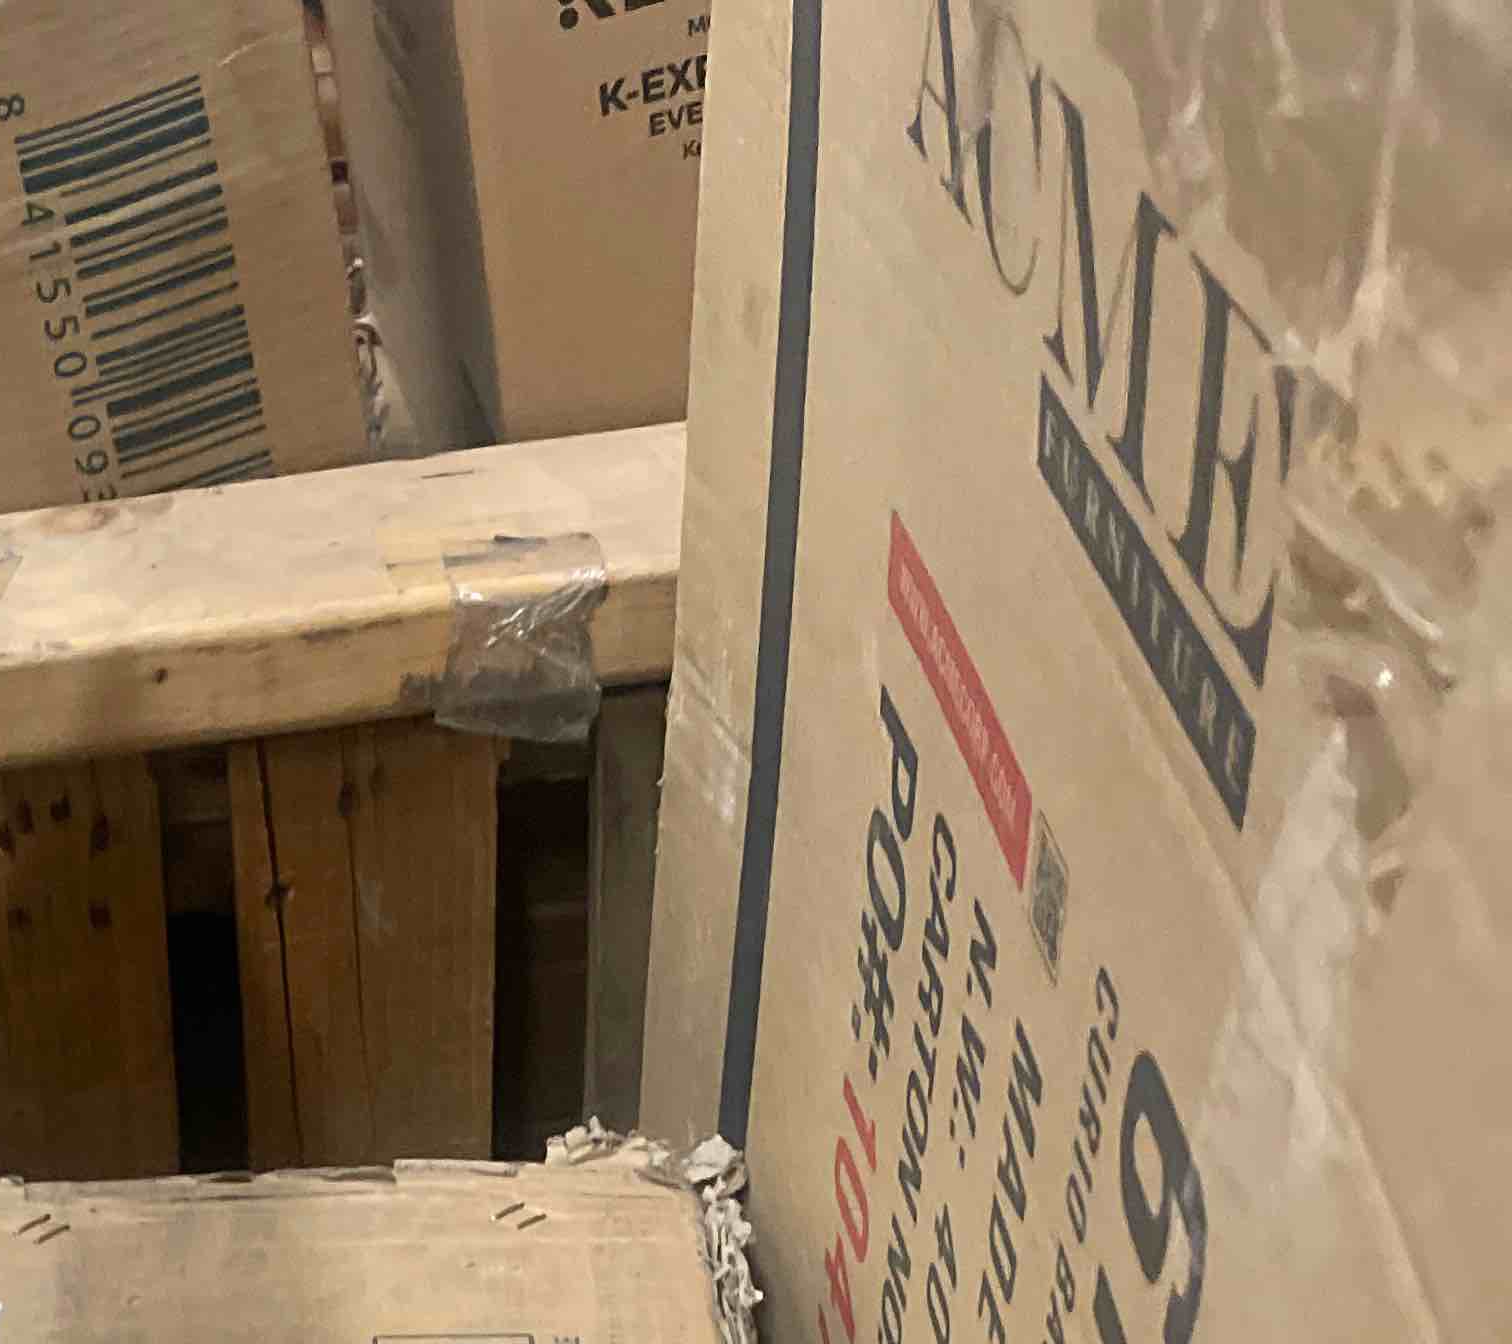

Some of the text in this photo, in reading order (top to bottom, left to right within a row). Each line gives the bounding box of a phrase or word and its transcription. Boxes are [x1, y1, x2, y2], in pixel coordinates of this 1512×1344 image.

[21, 201, 88, 378] 41550
[906, 0, 1297, 690] ACME
[1039, 415, 1246, 800] FURNITURE
[852, 684, 918, 1083] PO#:
[897, 813, 957, 1223] CARTON
[1068, 966, 1120, 1246] CURIO
